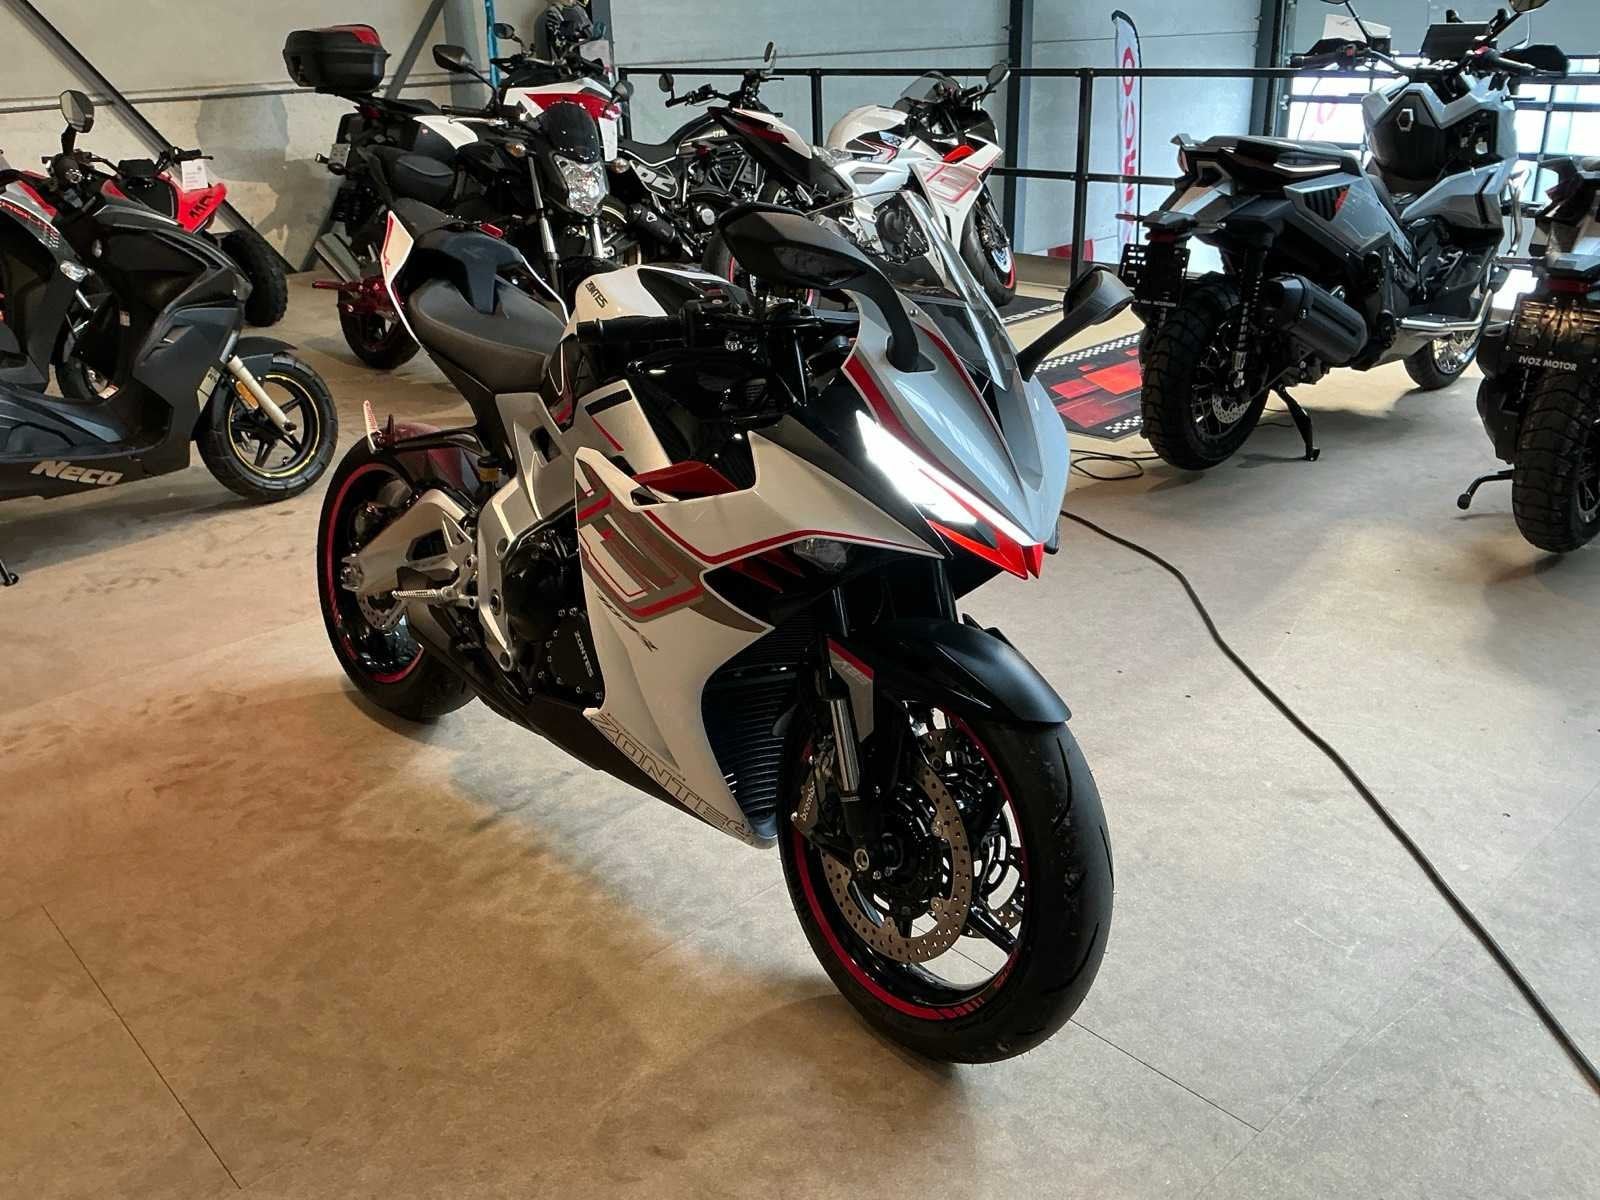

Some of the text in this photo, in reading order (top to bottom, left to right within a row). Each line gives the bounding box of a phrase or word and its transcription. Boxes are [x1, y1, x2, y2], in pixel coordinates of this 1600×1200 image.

[585, 281, 608, 308] ZONTES
[1518, 355, 1577, 371] IVOZ MOTOR
[30, 460, 124, 486] Neco
